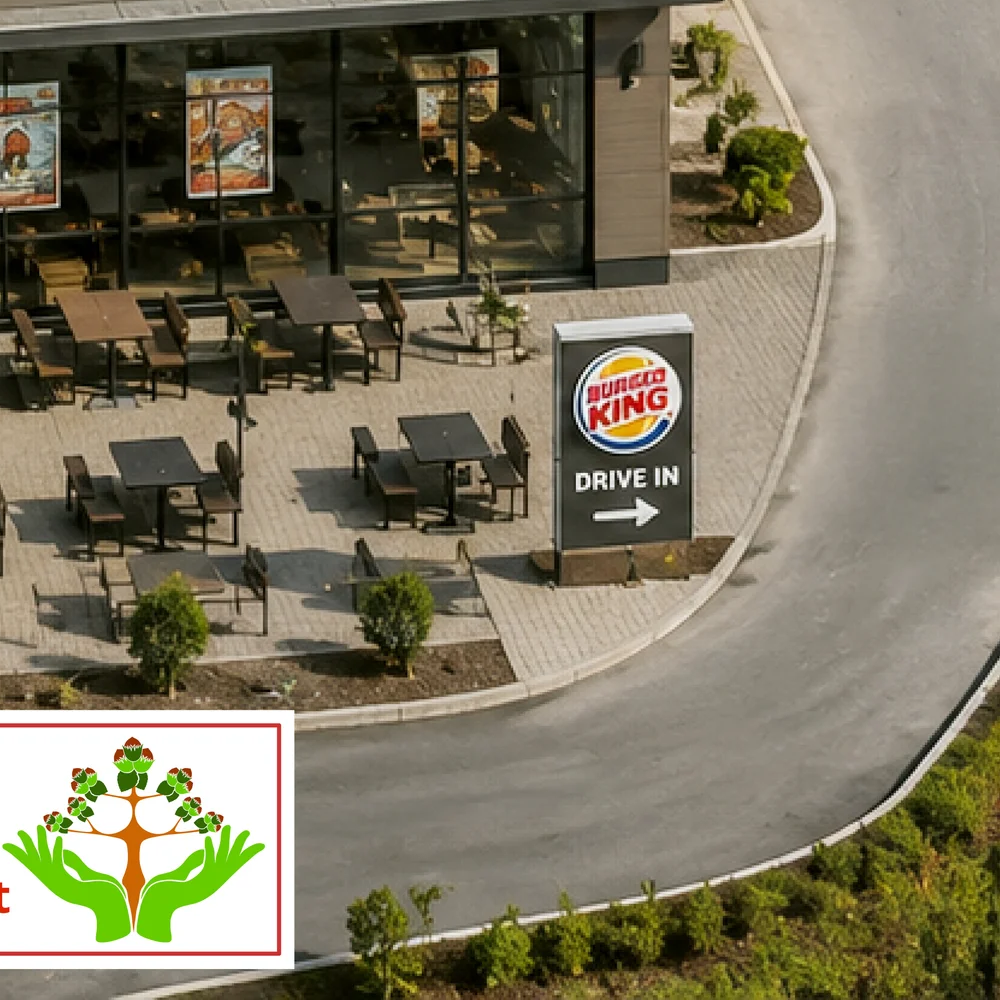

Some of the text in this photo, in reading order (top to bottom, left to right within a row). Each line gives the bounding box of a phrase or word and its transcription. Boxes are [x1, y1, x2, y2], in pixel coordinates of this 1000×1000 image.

[589, 386, 669, 431] KING
[575, 465, 680, 493] DRIVE IN
